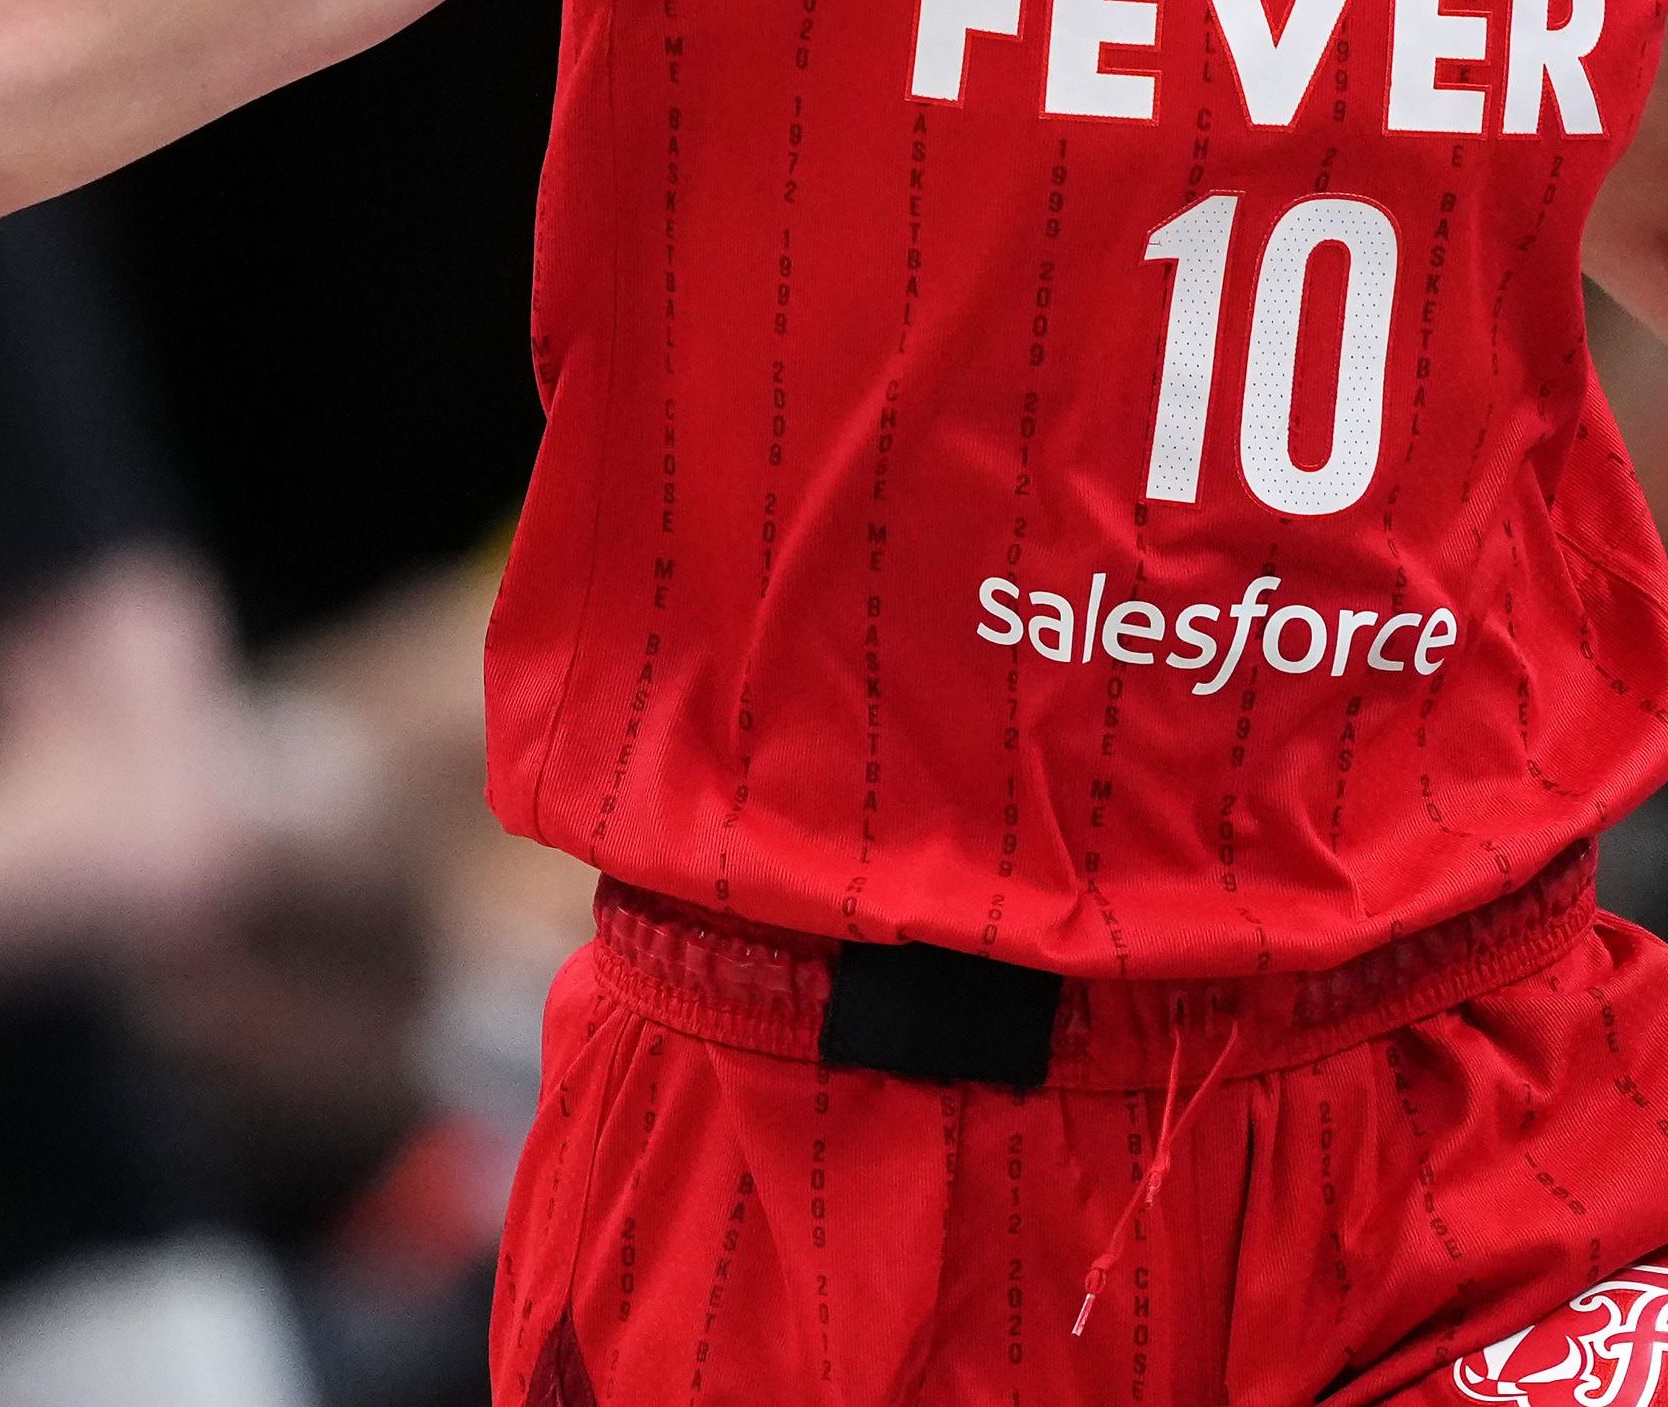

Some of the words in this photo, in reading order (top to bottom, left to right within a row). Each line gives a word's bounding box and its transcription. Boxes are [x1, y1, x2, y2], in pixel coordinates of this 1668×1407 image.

[664, 36, 682, 85] ME
[784, 96, 804, 204] 1972
[1043, 138, 1066, 240] 1999
[664, 106, 683, 377] BASKETBALL
[897, 101, 930, 355] ASKETBALL
[1029, 260, 1053, 369] 2009
[1143, 195, 1399, 516] 10
[1399, 192, 1456, 464] BASKETBALL
[661, 398, 677, 534] CHOSE
[872, 379, 899, 501] CHOSE
[1015, 391, 1040, 497] 2012
[652, 557, 674, 611] ME
[867, 522, 888, 574] ME
[976, 572, 1457, 696] salesforce
[859, 594, 883, 866] BASKETBALL
[1091, 779, 1114, 829] ME
[810, 1139, 828, 1249] 2009
[1007, 1133, 1024, 1235] 2012
[620, 1218, 637, 1323] 2009
[683, 1171, 748, 1407] BASKETBA
[1006, 1258, 1025, 1365] 2020
[815, 1274, 833, 1382] 2012
[1131, 1266, 1151, 1404] CHOSE
